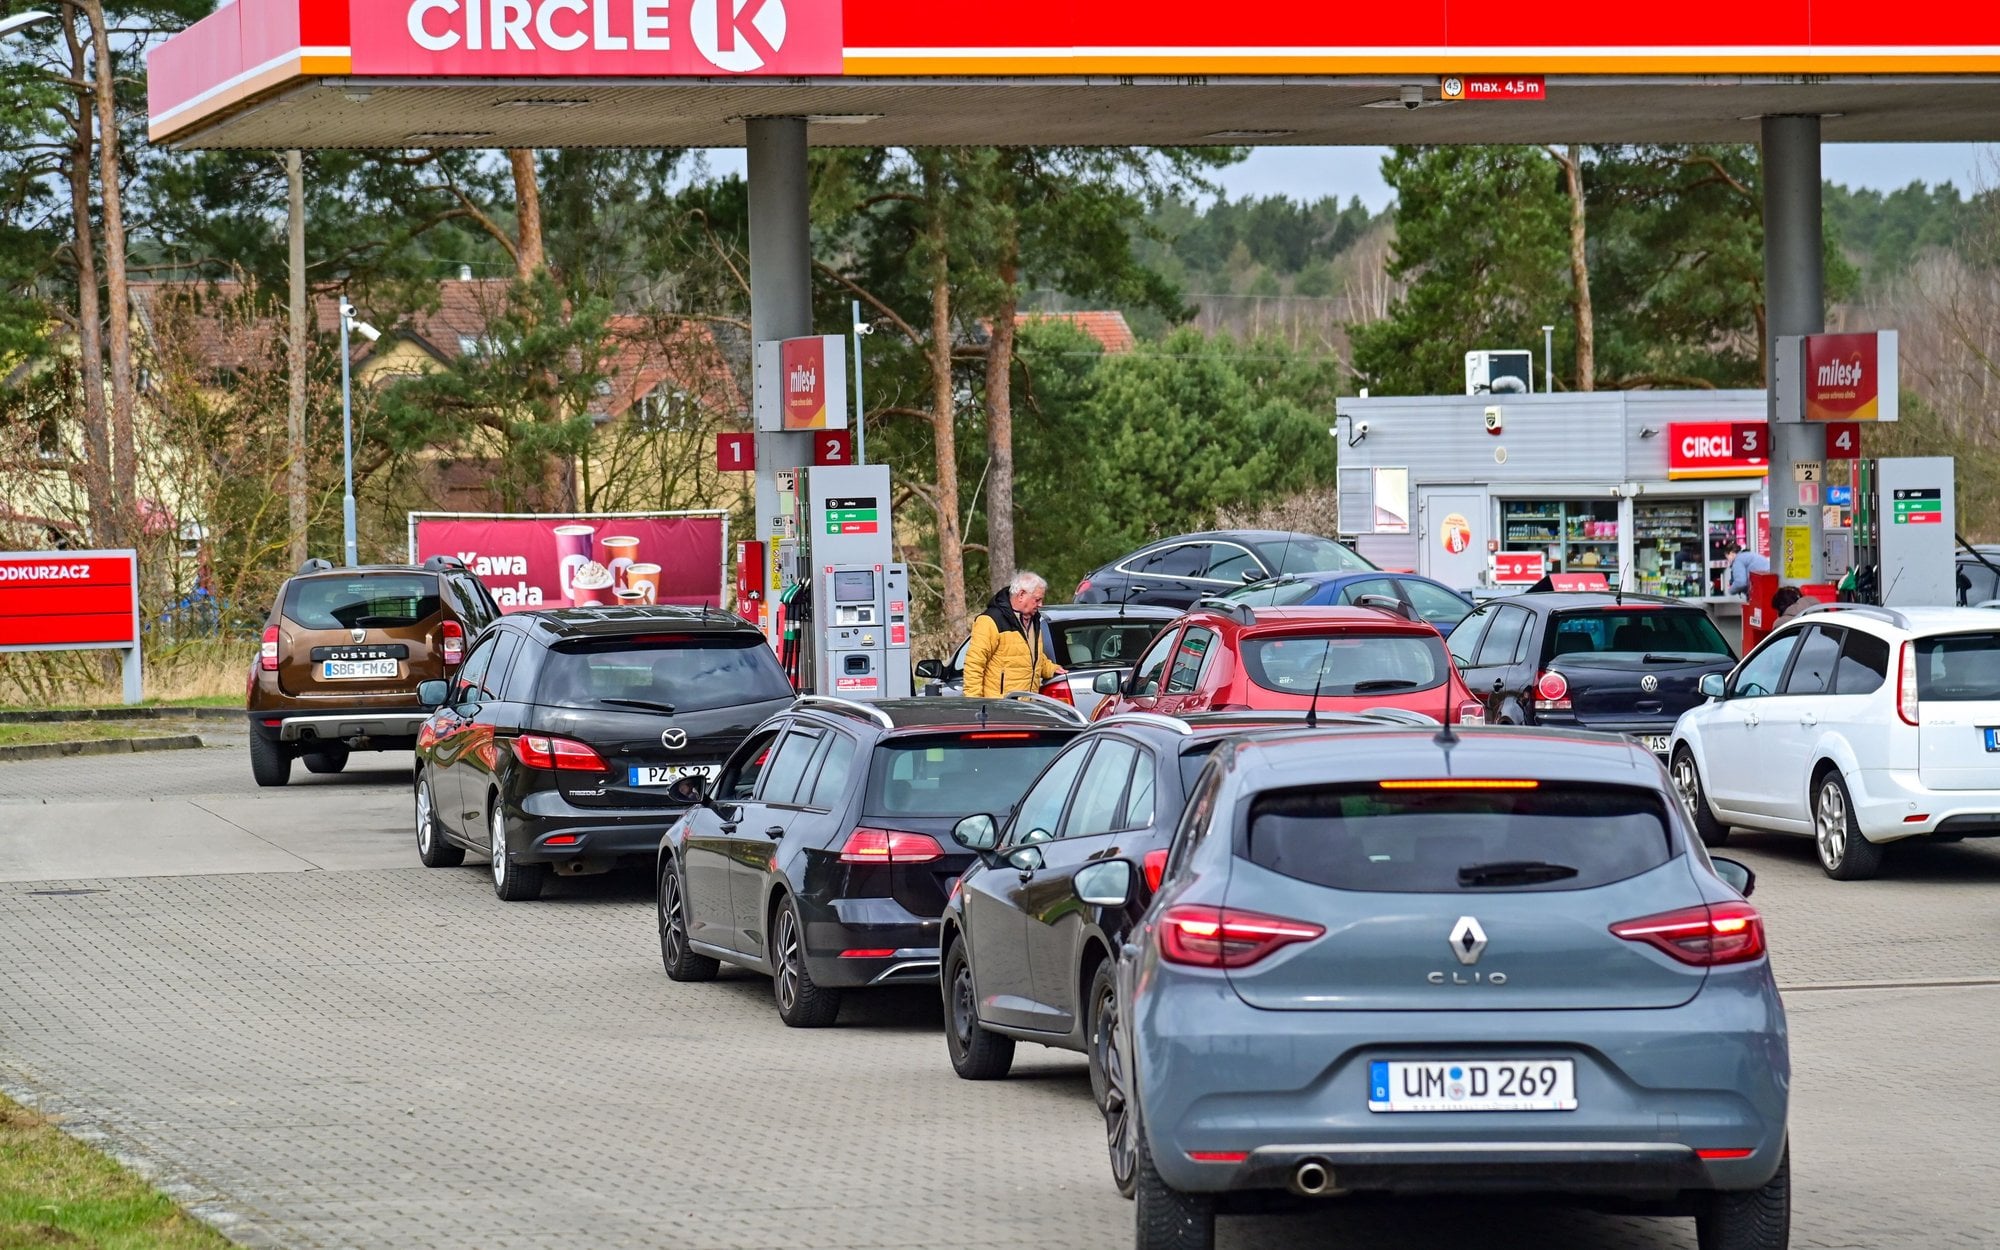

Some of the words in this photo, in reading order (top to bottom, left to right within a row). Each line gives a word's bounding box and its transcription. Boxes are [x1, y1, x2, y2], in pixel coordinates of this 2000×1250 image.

[407, 0, 670, 50] CIRCLE
[704, 0, 785, 71] K
[1471, 82, 1501, 92] max.
[1505, 81, 1524, 94] 4,5
[1526, 82, 1538, 92] m
[826, 440, 841, 460] 2
[1682, 436, 1733, 458] CIRCL
[1742, 431, 1757, 451] 3
[1835, 430, 1852, 450] 4
[730, 442, 741, 462] 1
[787, 480, 794, 490] 2
[1804, 470, 1813, 480] 2
[0, 565, 90, 580] ODKURZACZ
[457, 552, 527, 576] Kawa
[491, 581, 543, 606] rała
[332, 663, 355, 675] SBG
[362, 663, 378, 674] FM
[380, 663, 395, 673] 62
[1652, 737, 1666, 749] AS
[649, 767, 668, 782] PZ
[678, 766, 687, 778] S
[1427, 971, 1508, 984] CLIO
[1403, 1067, 1446, 1098] UM
[1470, 1067, 1488, 1098] D
[1498, 1066, 1558, 1097] 269
